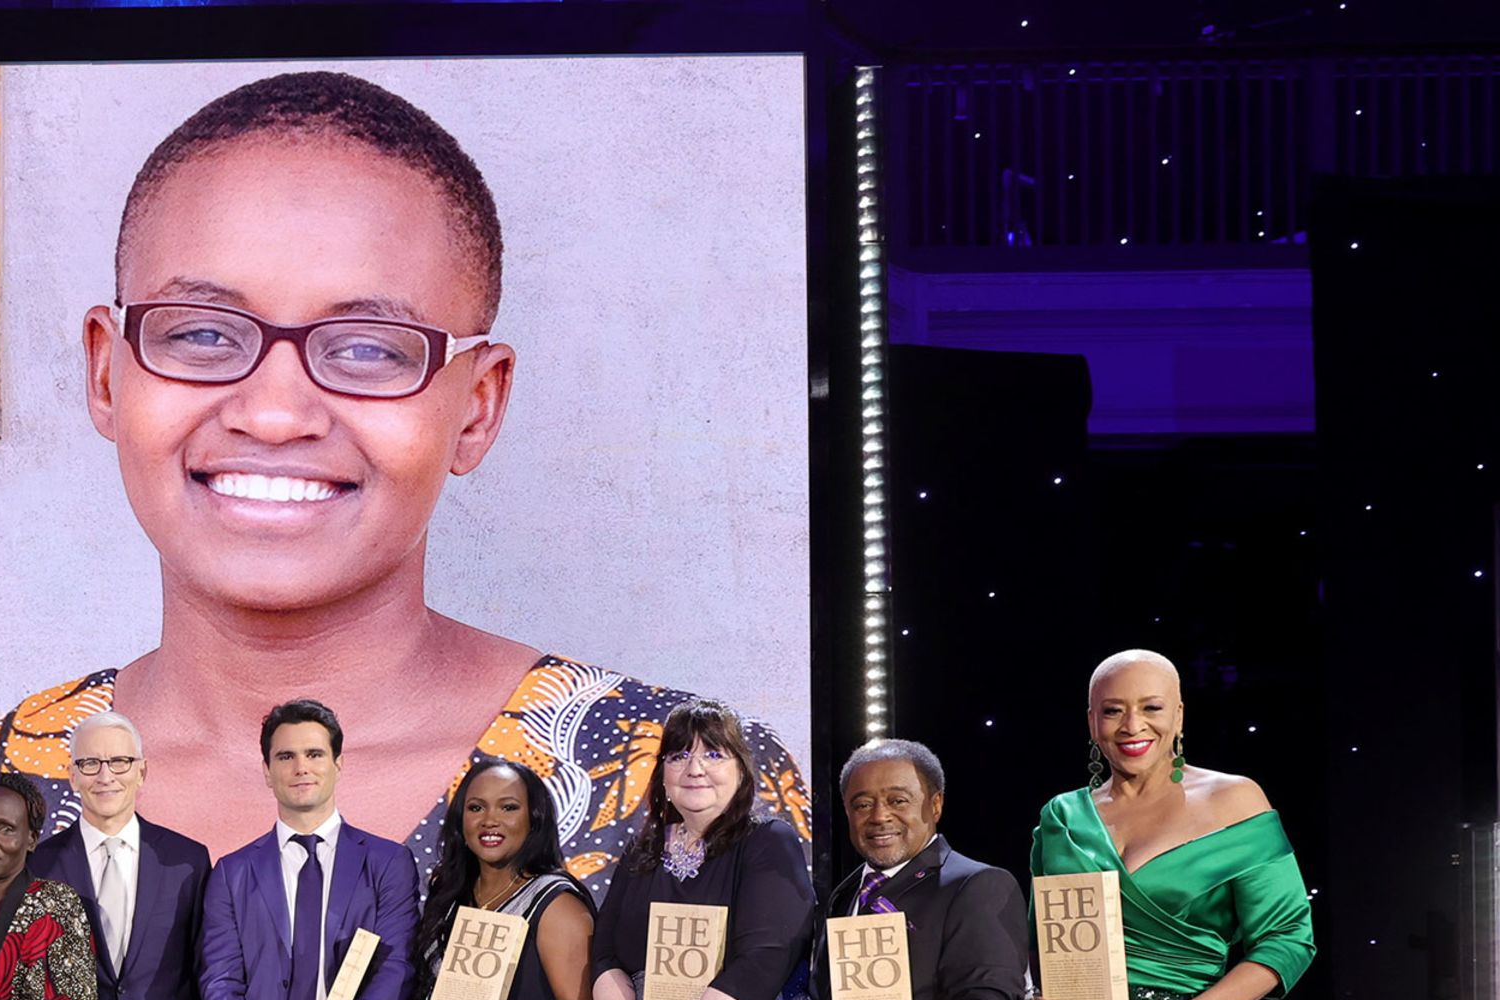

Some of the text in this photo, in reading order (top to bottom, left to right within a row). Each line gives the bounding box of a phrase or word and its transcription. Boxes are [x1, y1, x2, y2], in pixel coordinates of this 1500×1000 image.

[1040, 886, 1099, 921] HE
[454, 918, 510, 952] HE
[654, 915, 710, 948] HE
[834, 926, 901, 960] HE
[1044, 920, 1100, 954] RO
[446, 945, 502, 979] RO
[651, 946, 709, 979] RO
[837, 957, 901, 991] RO
